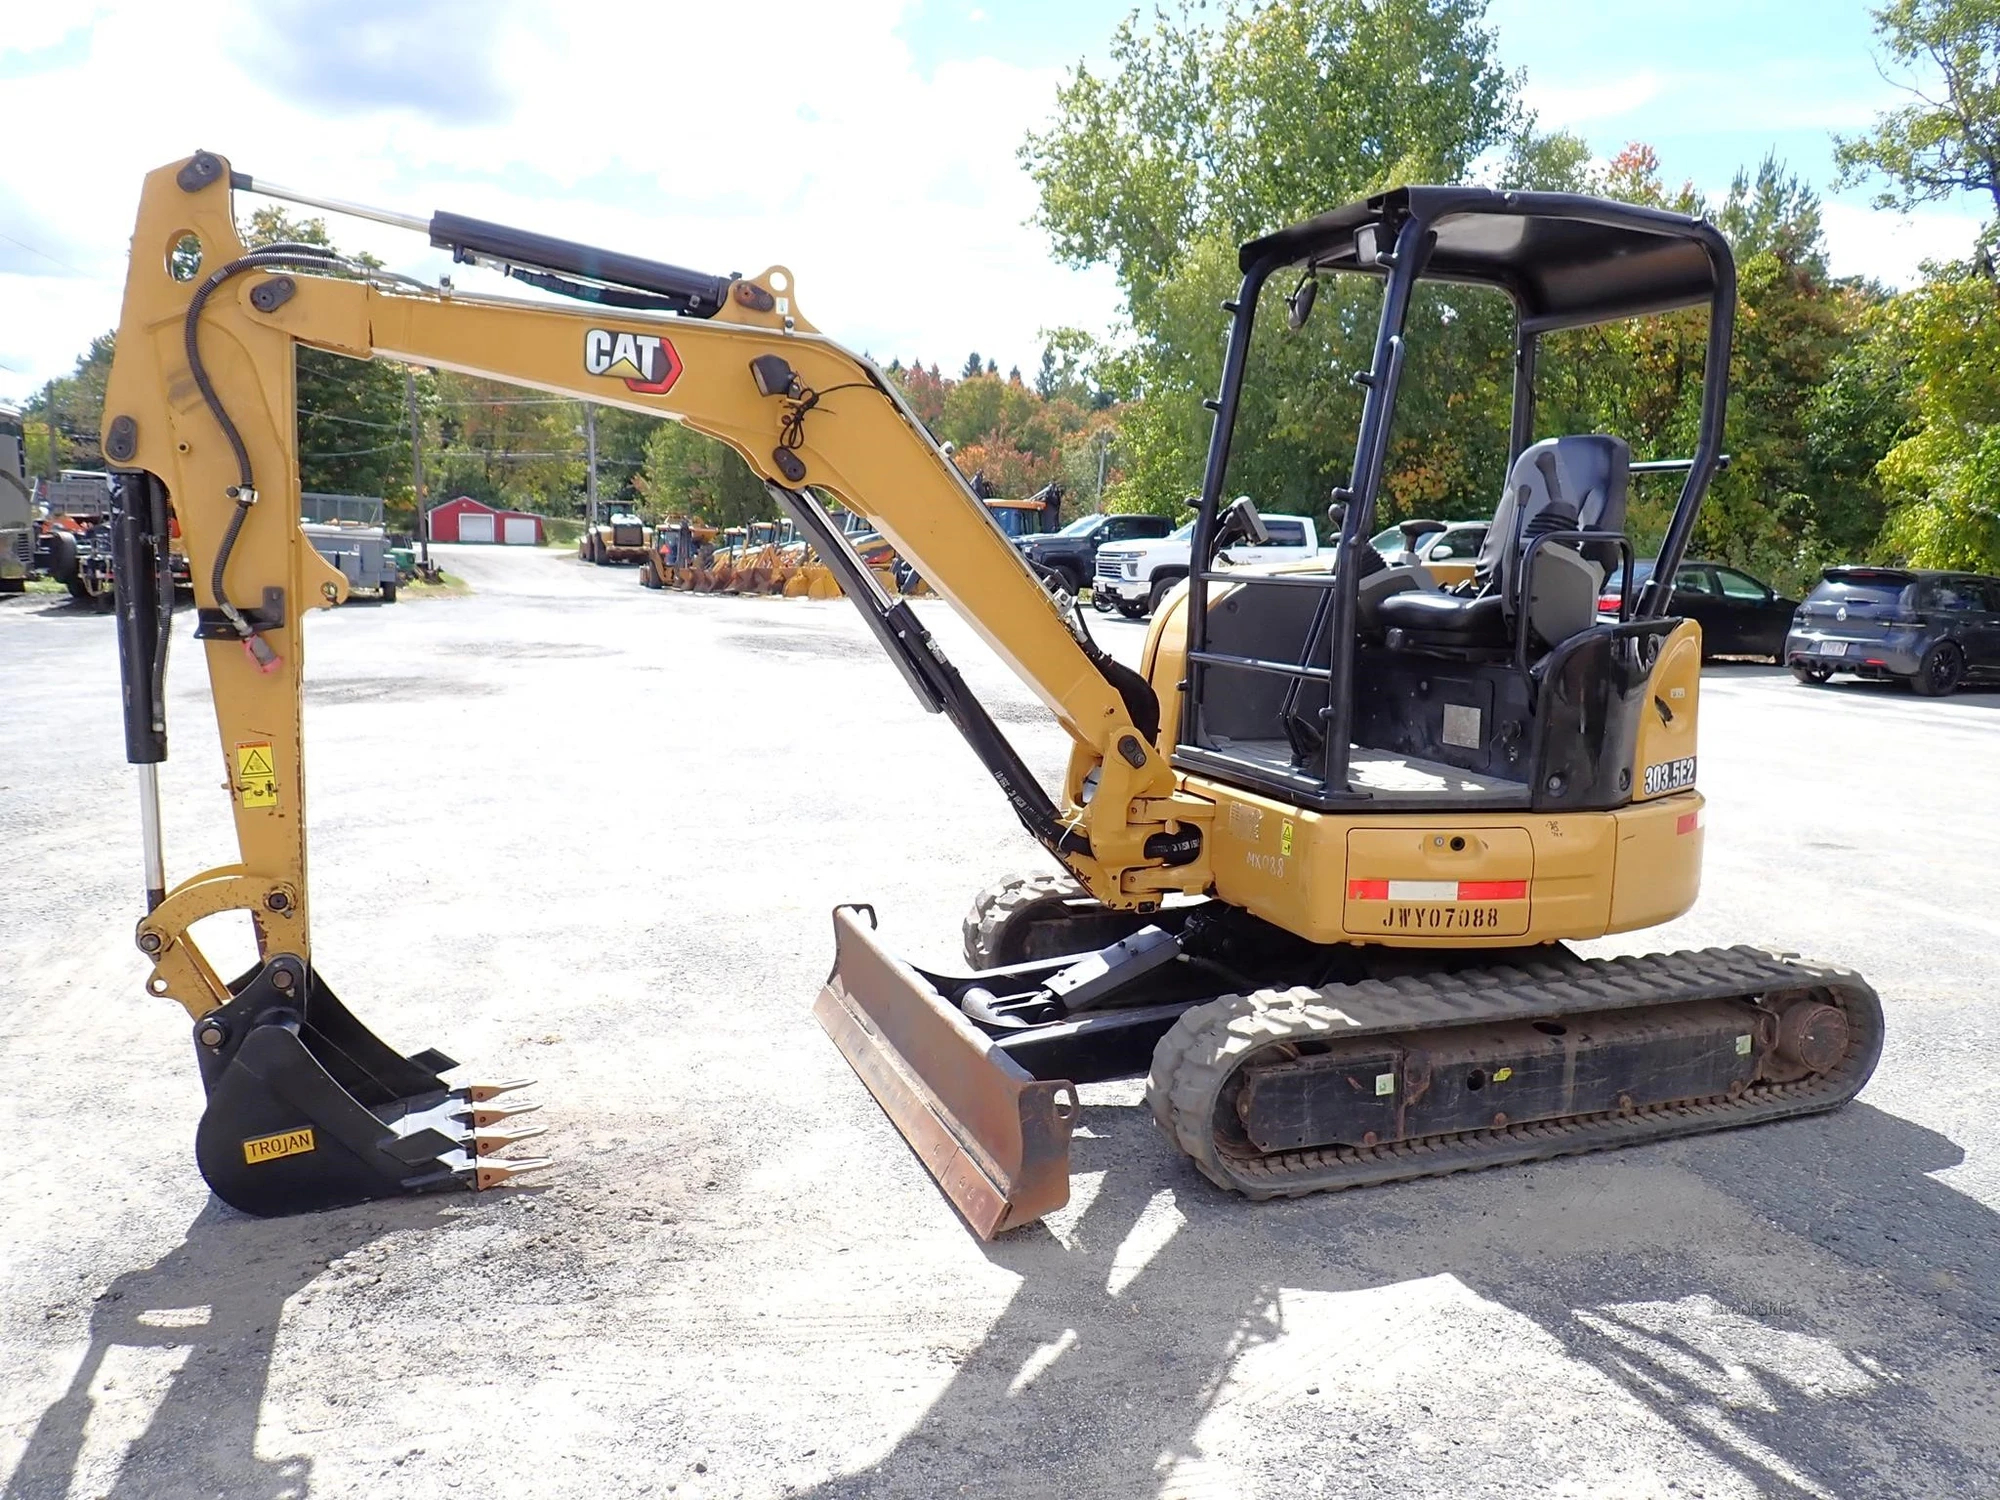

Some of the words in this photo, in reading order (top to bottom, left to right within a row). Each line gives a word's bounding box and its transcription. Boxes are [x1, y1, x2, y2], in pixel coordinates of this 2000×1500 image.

[586, 329, 660, 381] CAT
[1645, 758, 1694, 794] 303.5E2
[1383, 907, 1498, 928] JWY07088
[248, 1133, 310, 1157] TROJAN
